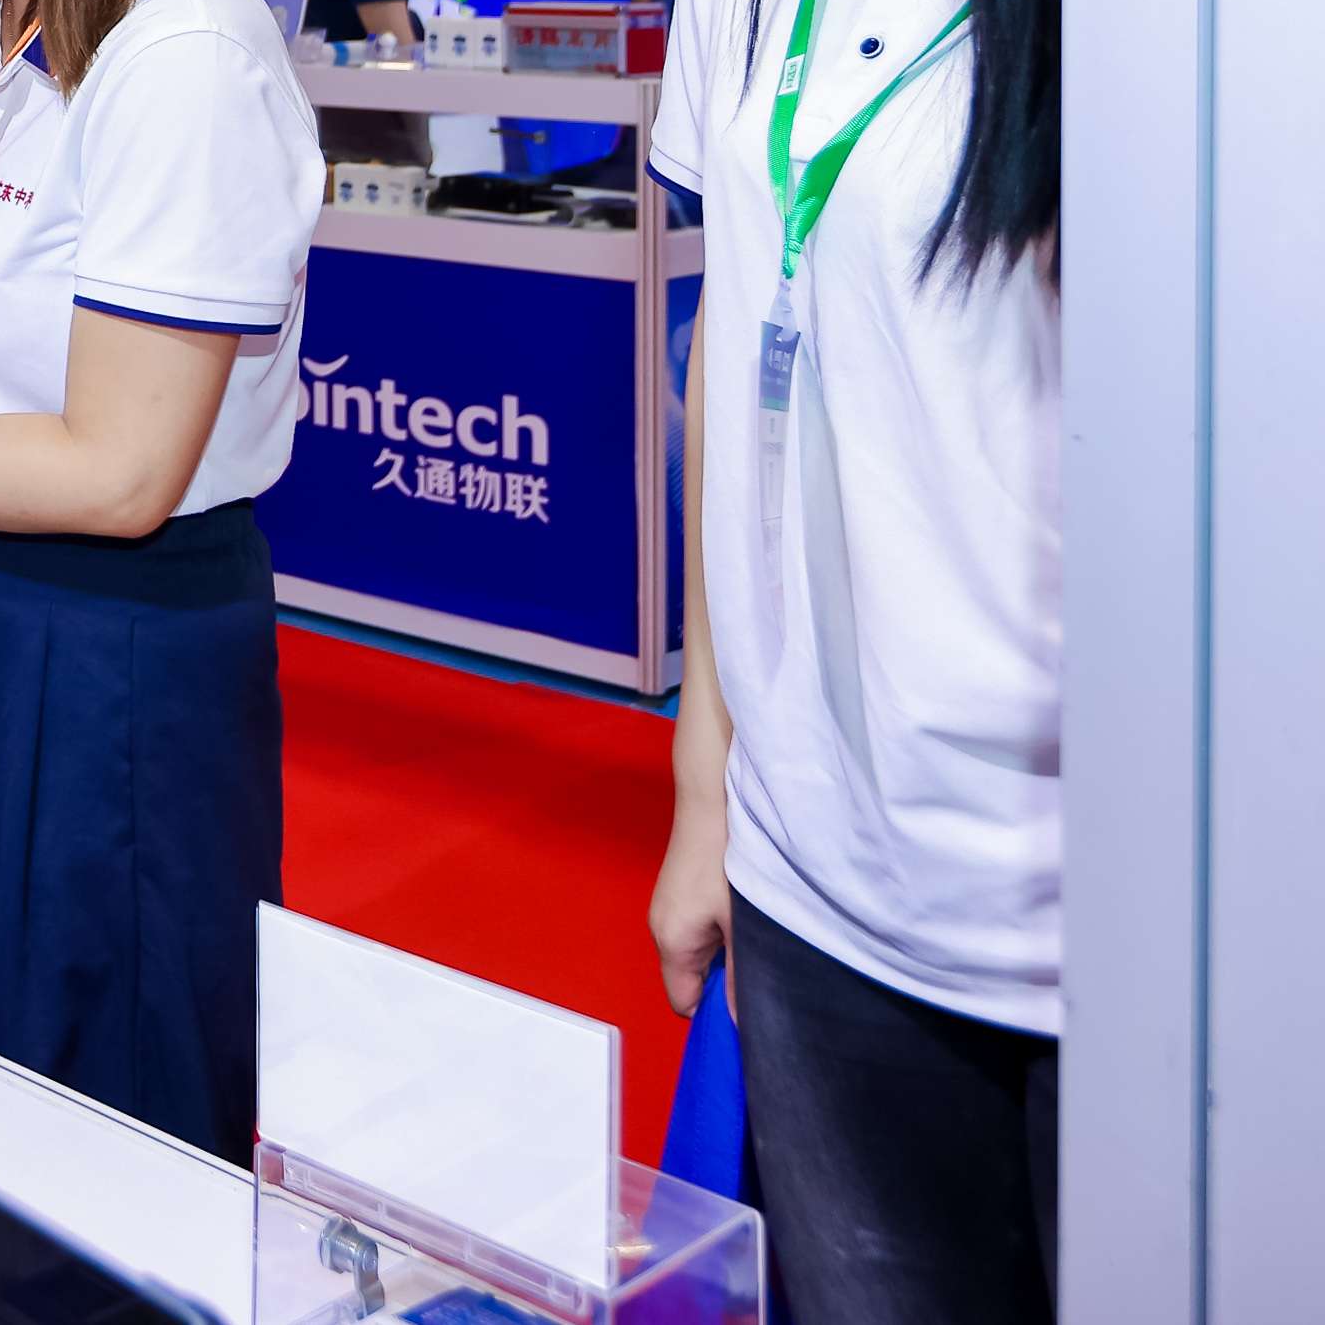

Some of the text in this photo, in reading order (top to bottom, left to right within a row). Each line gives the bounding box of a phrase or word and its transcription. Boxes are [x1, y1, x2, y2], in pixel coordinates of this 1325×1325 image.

[297, 354, 549, 465] intech
[371, 447, 549, 523] 久通物联
